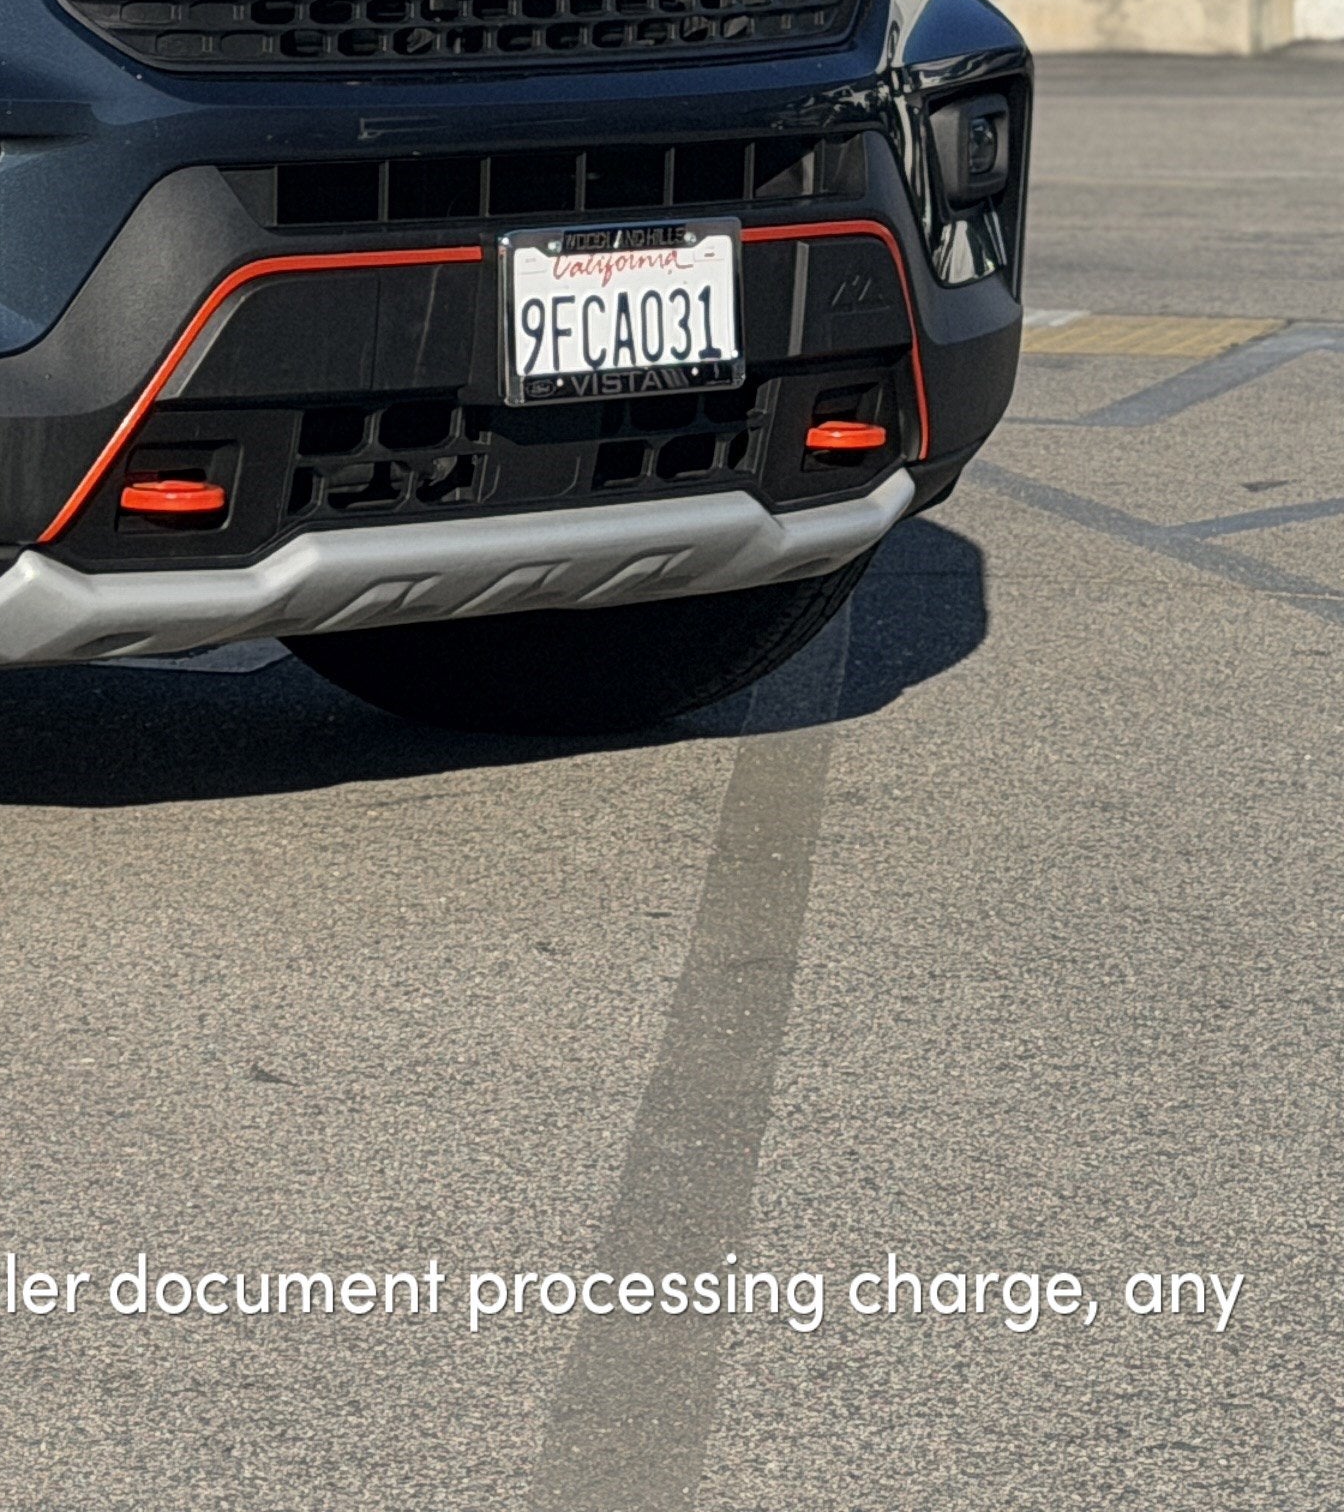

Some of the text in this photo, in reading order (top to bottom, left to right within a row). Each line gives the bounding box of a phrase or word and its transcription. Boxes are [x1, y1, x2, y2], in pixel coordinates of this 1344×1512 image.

[552, 250, 694, 288] California
[521, 285, 723, 375] 9FCA031
[571, 369, 664, 396] VISTA
